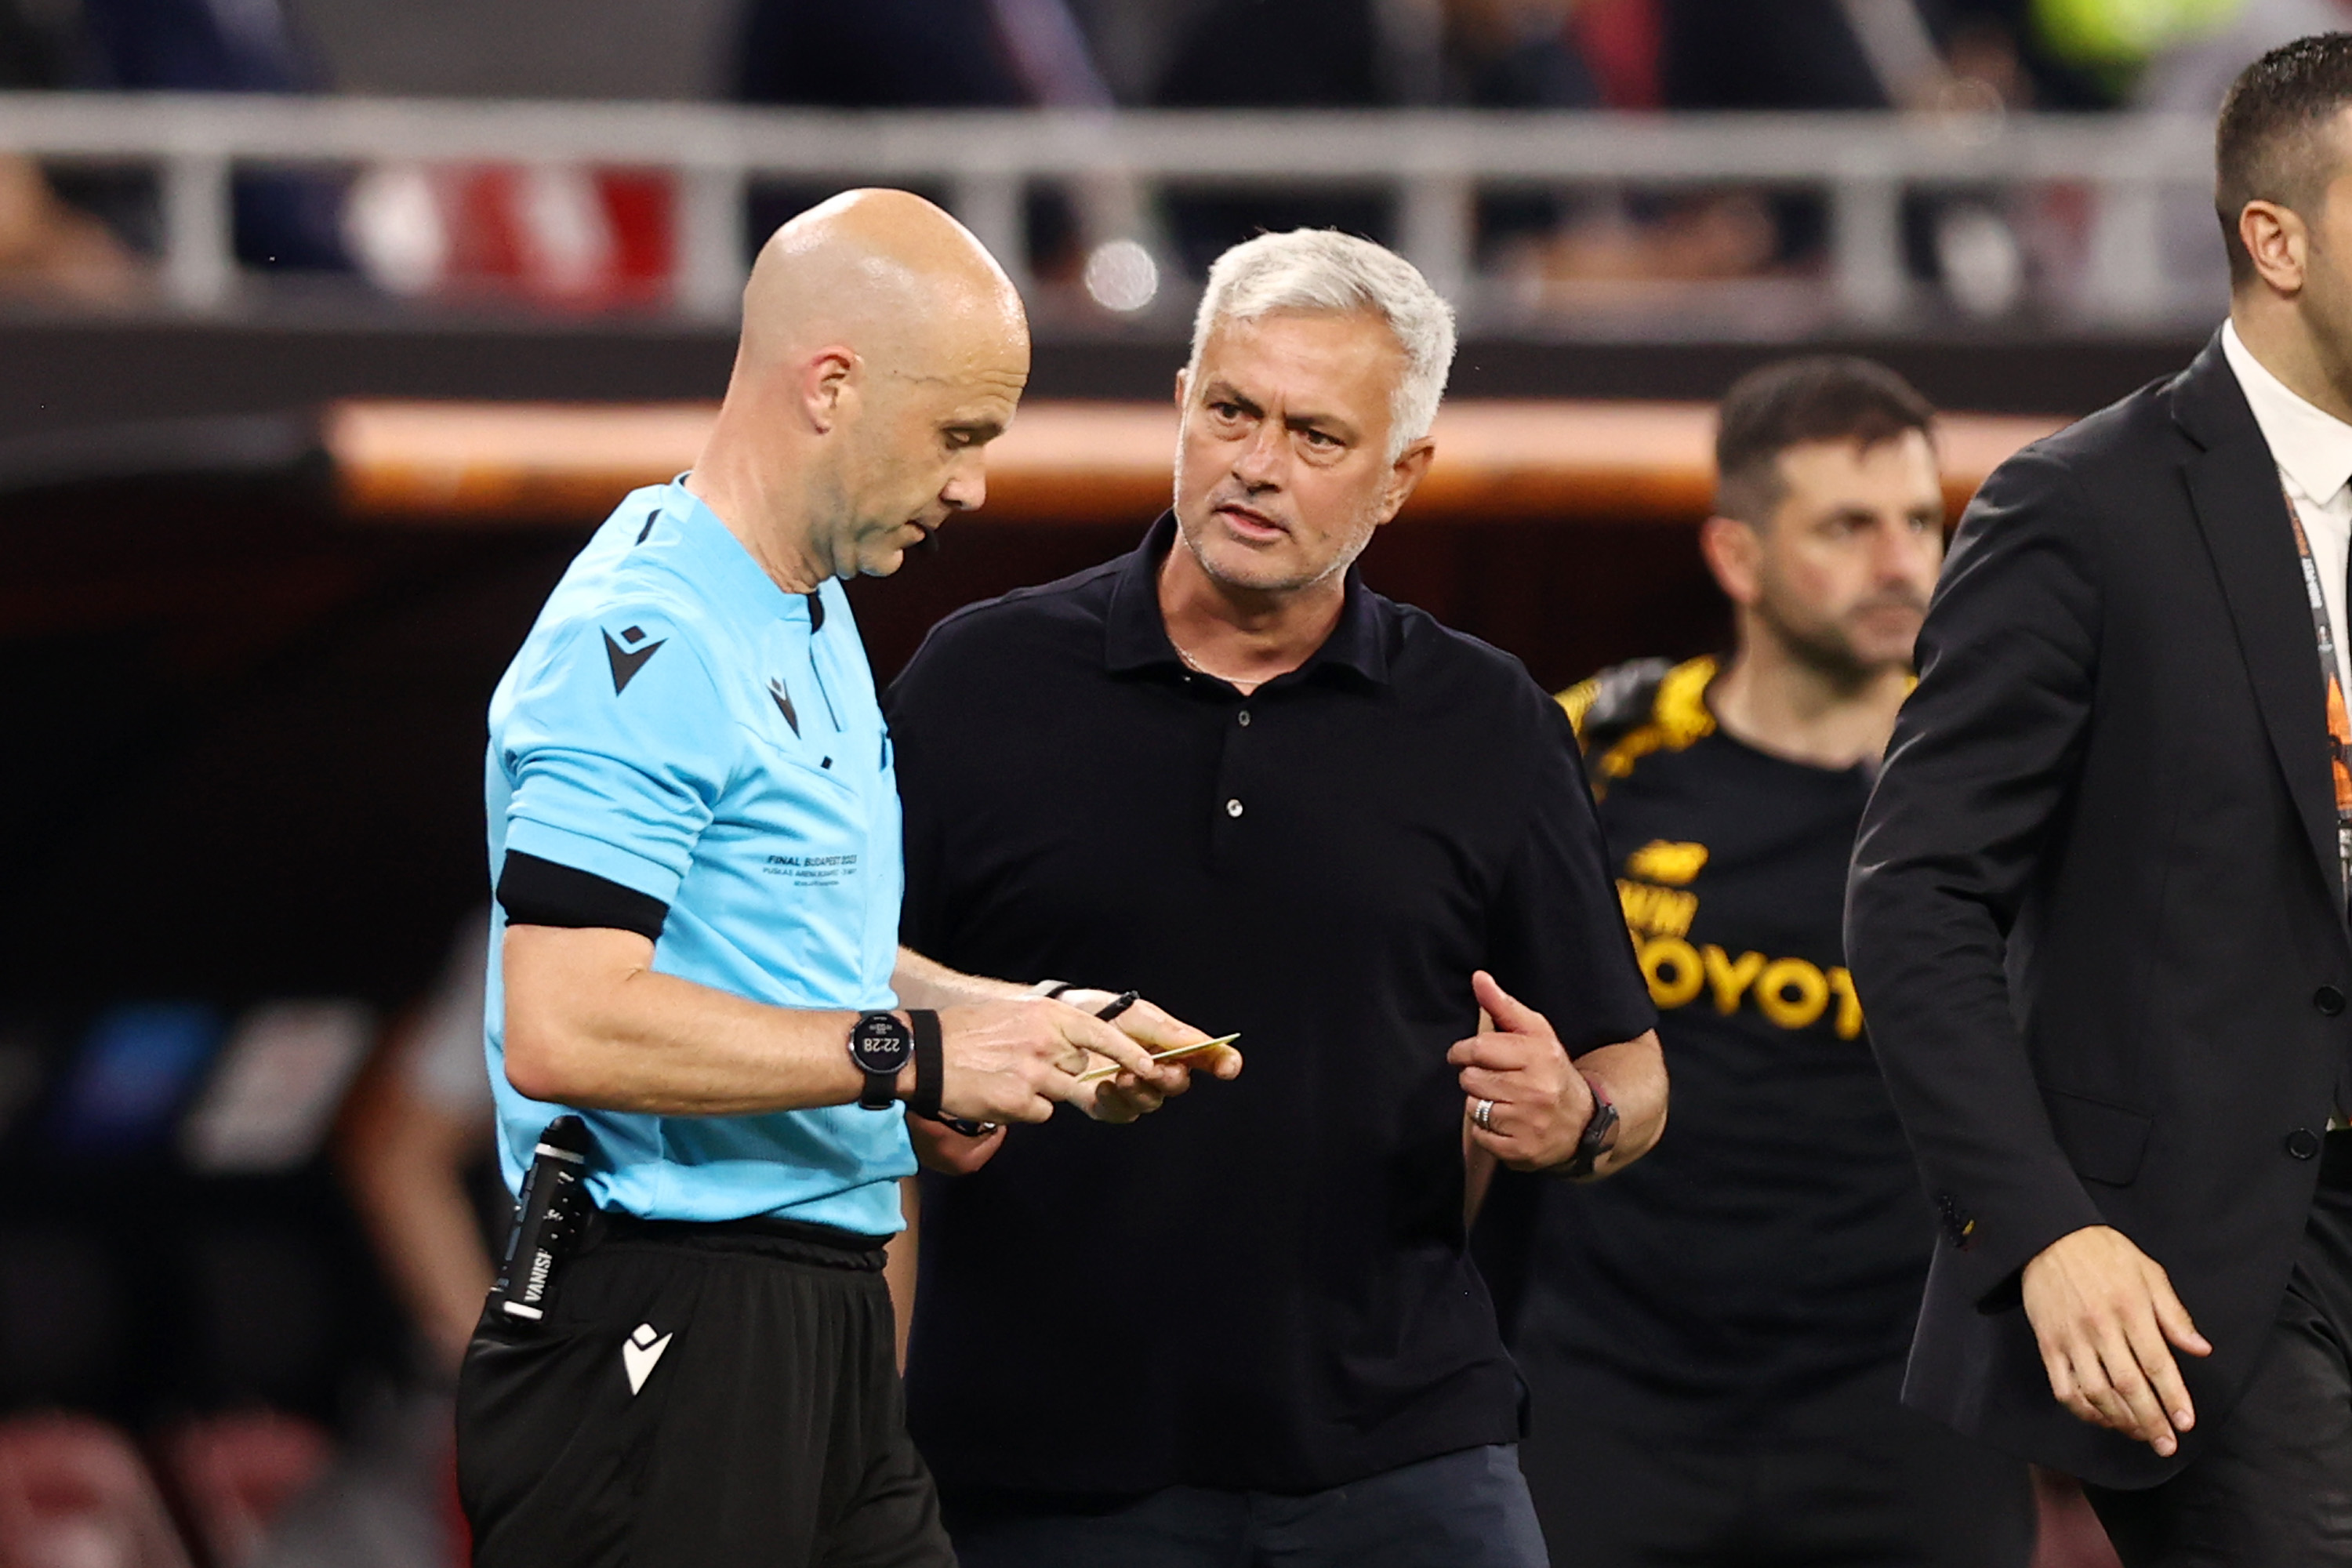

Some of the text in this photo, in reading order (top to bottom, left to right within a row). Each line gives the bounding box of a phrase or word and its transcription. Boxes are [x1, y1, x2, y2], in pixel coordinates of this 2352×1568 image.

[768, 855, 800, 866] FINAL
[1631, 931, 1864, 1040] OYOT
[864, 1038, 900, 1052] 22:28
